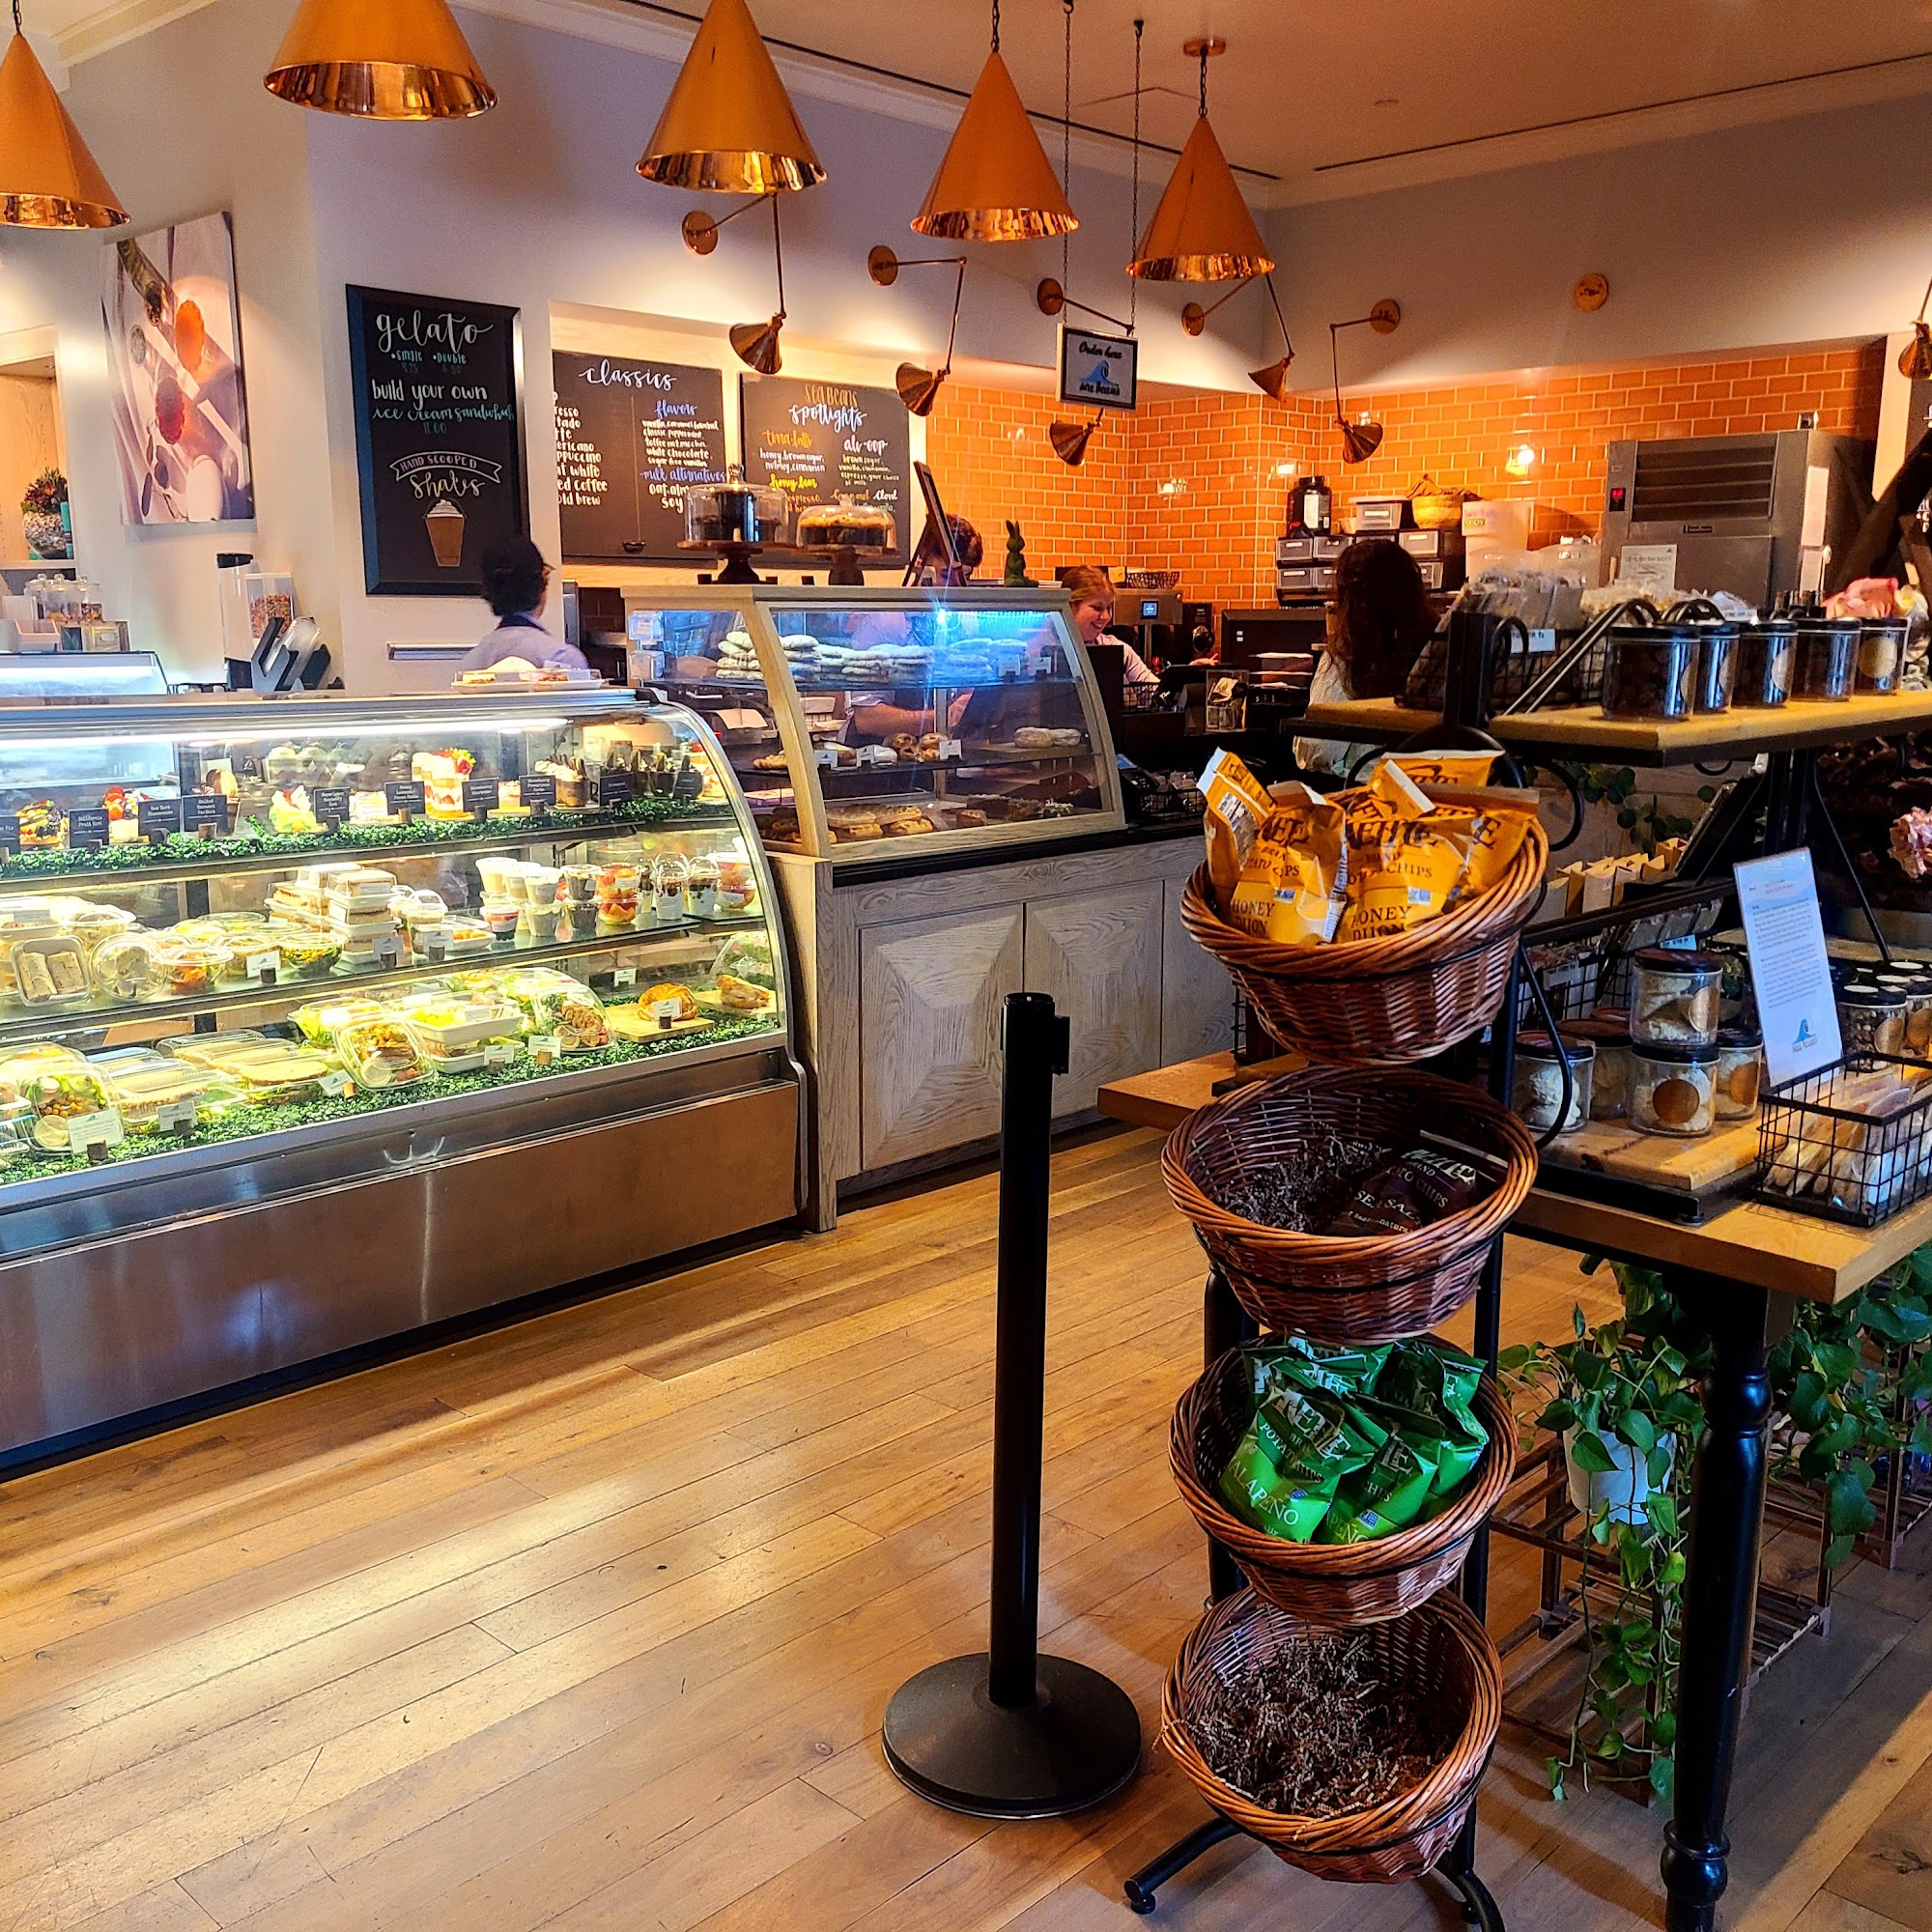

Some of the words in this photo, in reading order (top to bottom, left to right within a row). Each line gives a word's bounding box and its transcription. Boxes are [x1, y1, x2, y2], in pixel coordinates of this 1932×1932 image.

[376, 309, 494, 354] gelato
[579, 358, 676, 391] classics
[371, 379, 405, 402] build
[411, 384, 444, 411] your
[451, 384, 488, 400] own
[372, 406, 404, 419] ice
[407, 408, 453, 421] cream
[554, 406, 580, 417] resso
[654, 399, 697, 419] flavors
[555, 415, 581, 429] tado
[788, 403, 867, 433] spotlights
[554, 427, 572, 441] tte
[556, 440, 595, 453] ericano
[400, 455, 424, 472] HAND
[427, 454, 478, 469] SCOOPED
[556, 450, 602, 463] ppuccino
[570, 464, 600, 478] white
[556, 476, 571, 492] ed
[574, 477, 609, 493] coffee
[558, 492, 574, 505] old
[575, 492, 601, 505] brew
[662, 497, 684, 514] soy
[1386, 863, 1434, 878] CHIPS
[1232, 898, 1275, 917] HONEY
[1230, 1460, 1299, 1524] ALAPEÑO
